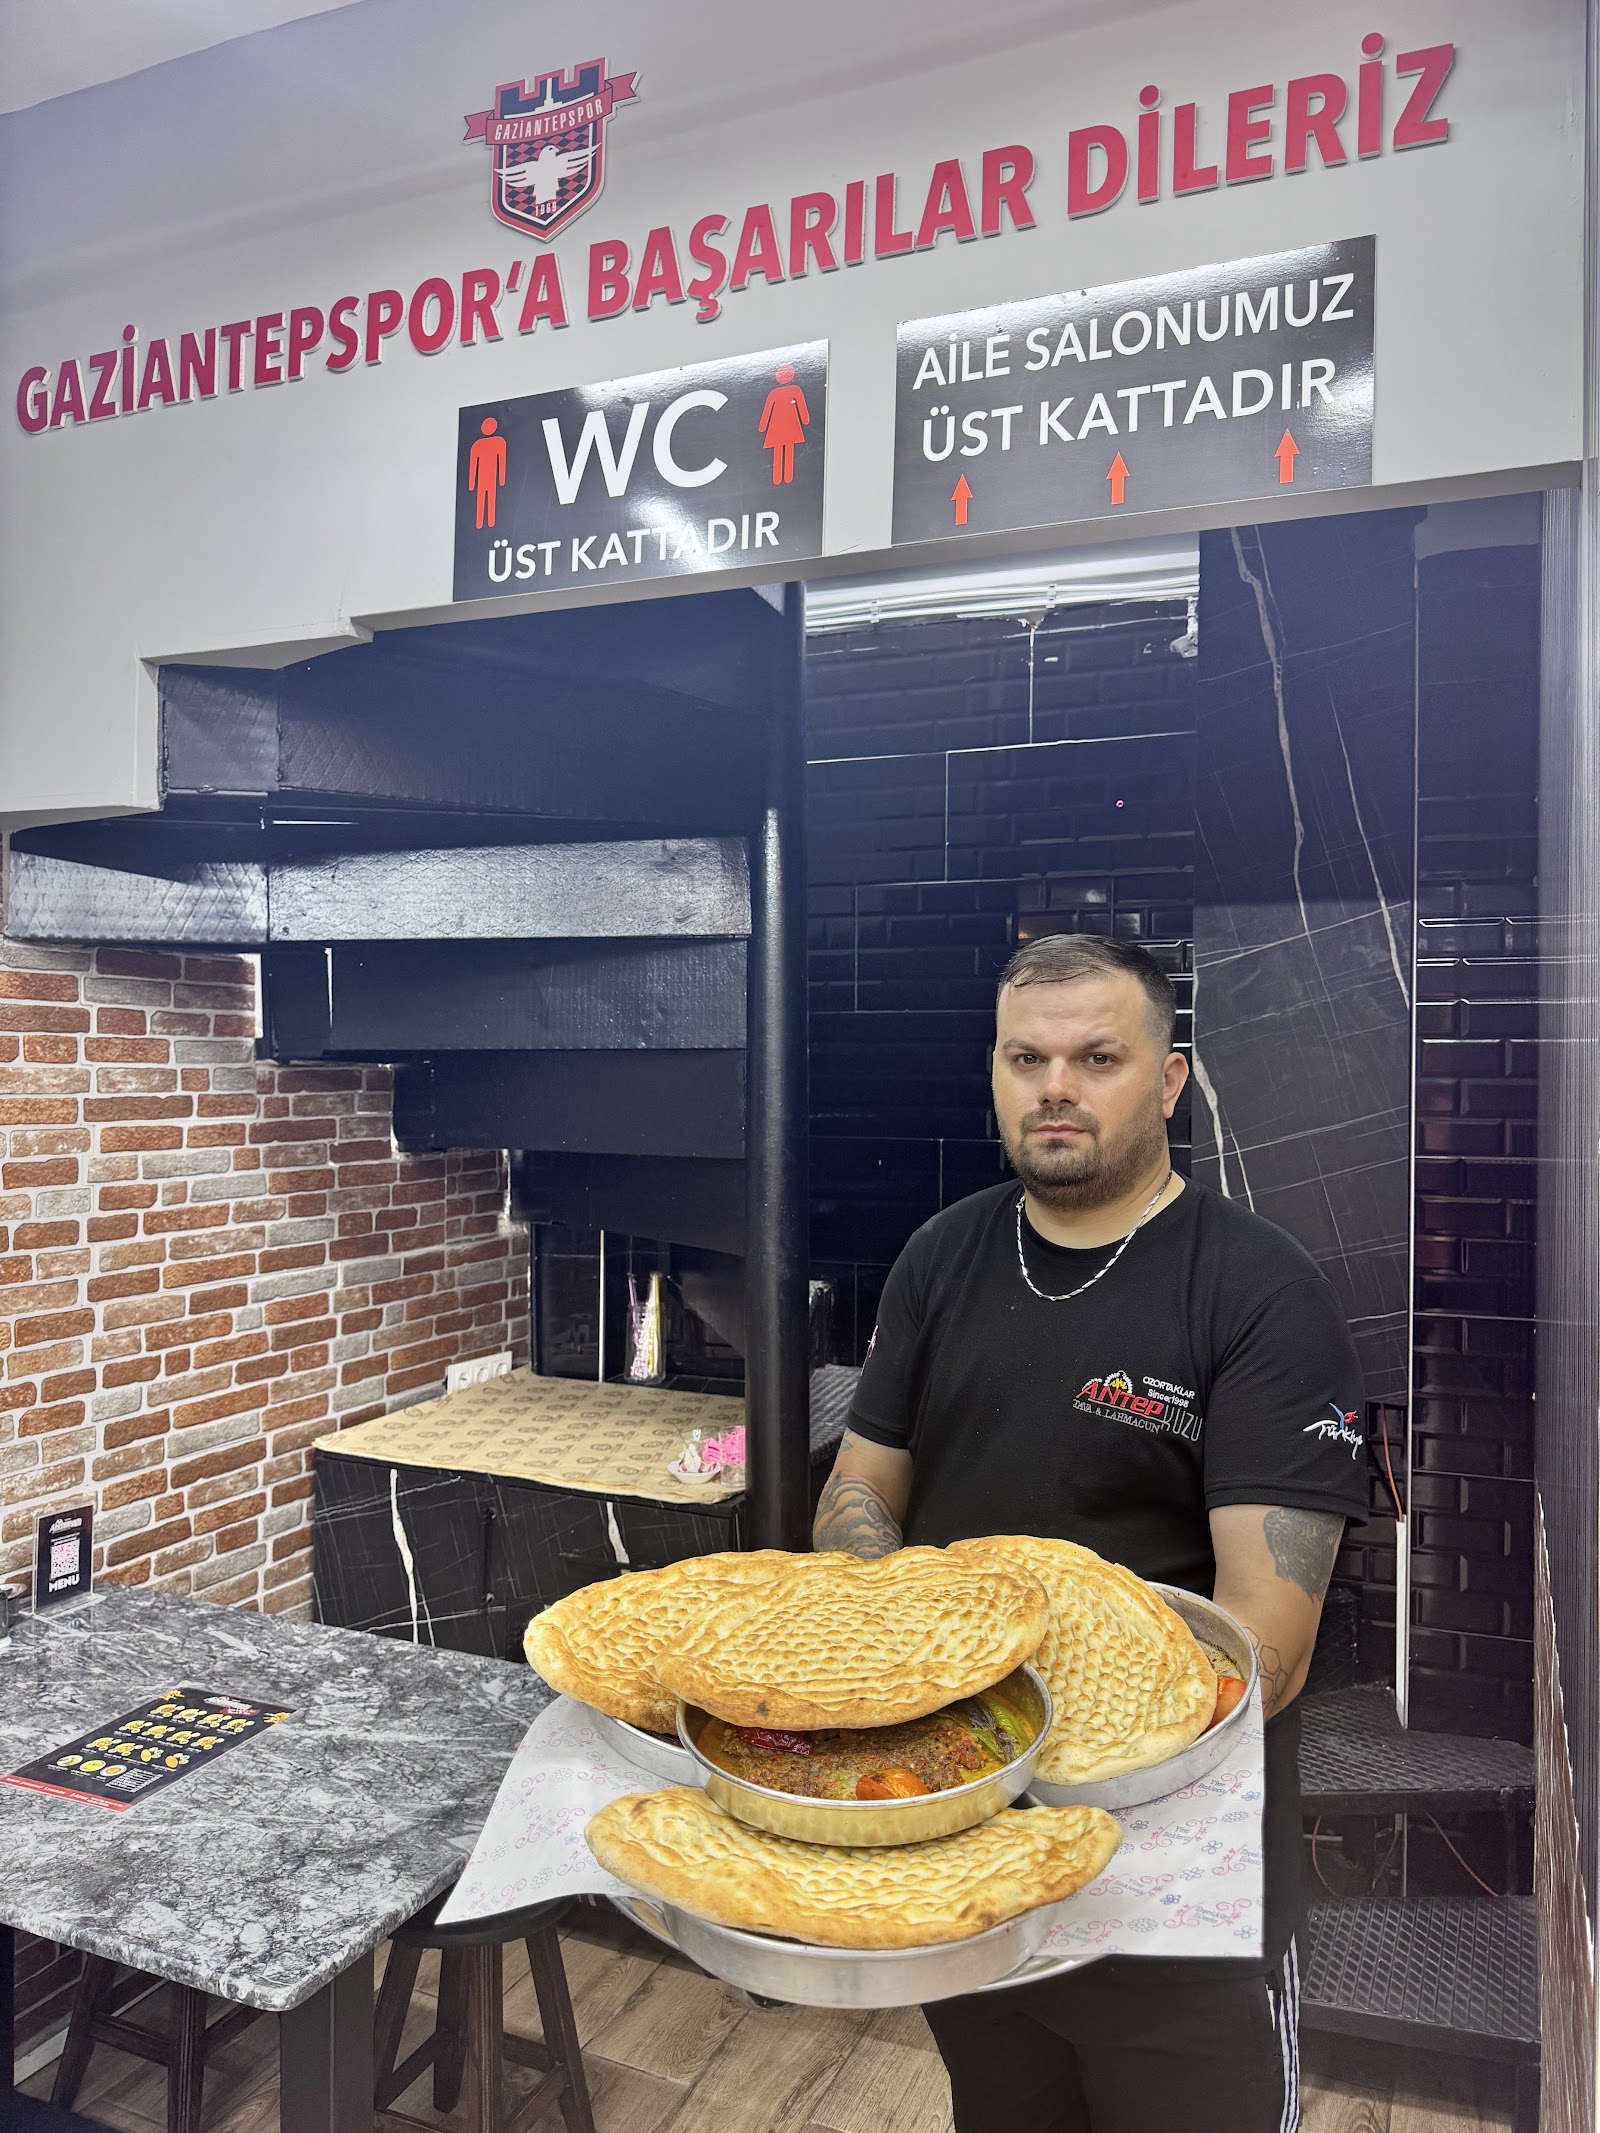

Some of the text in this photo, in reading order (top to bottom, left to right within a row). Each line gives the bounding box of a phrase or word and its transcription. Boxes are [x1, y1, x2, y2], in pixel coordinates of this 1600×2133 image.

[494, 98, 603, 141] GAZİANTEPSPOR
[588, 145, 1036, 322] BAŞARILAR
[1068, 32, 1454, 219] DİLERİZ
[535, 202, 557, 216] 1969
[912, 273, 1355, 390] AİLE SALONUMUZ
[922, 358, 1336, 462] ÜST KATTADIR
[542, 389, 729, 505] WC
[488, 511, 781, 582] ÜST KATTADIR
[1095, 1407, 1102, 1417] &
[1104, 1408, 1161, 1434] LAHMACUN
[1161, 1404, 1203, 1442] KUZU
[48, 1573, 80, 1593] MENU
